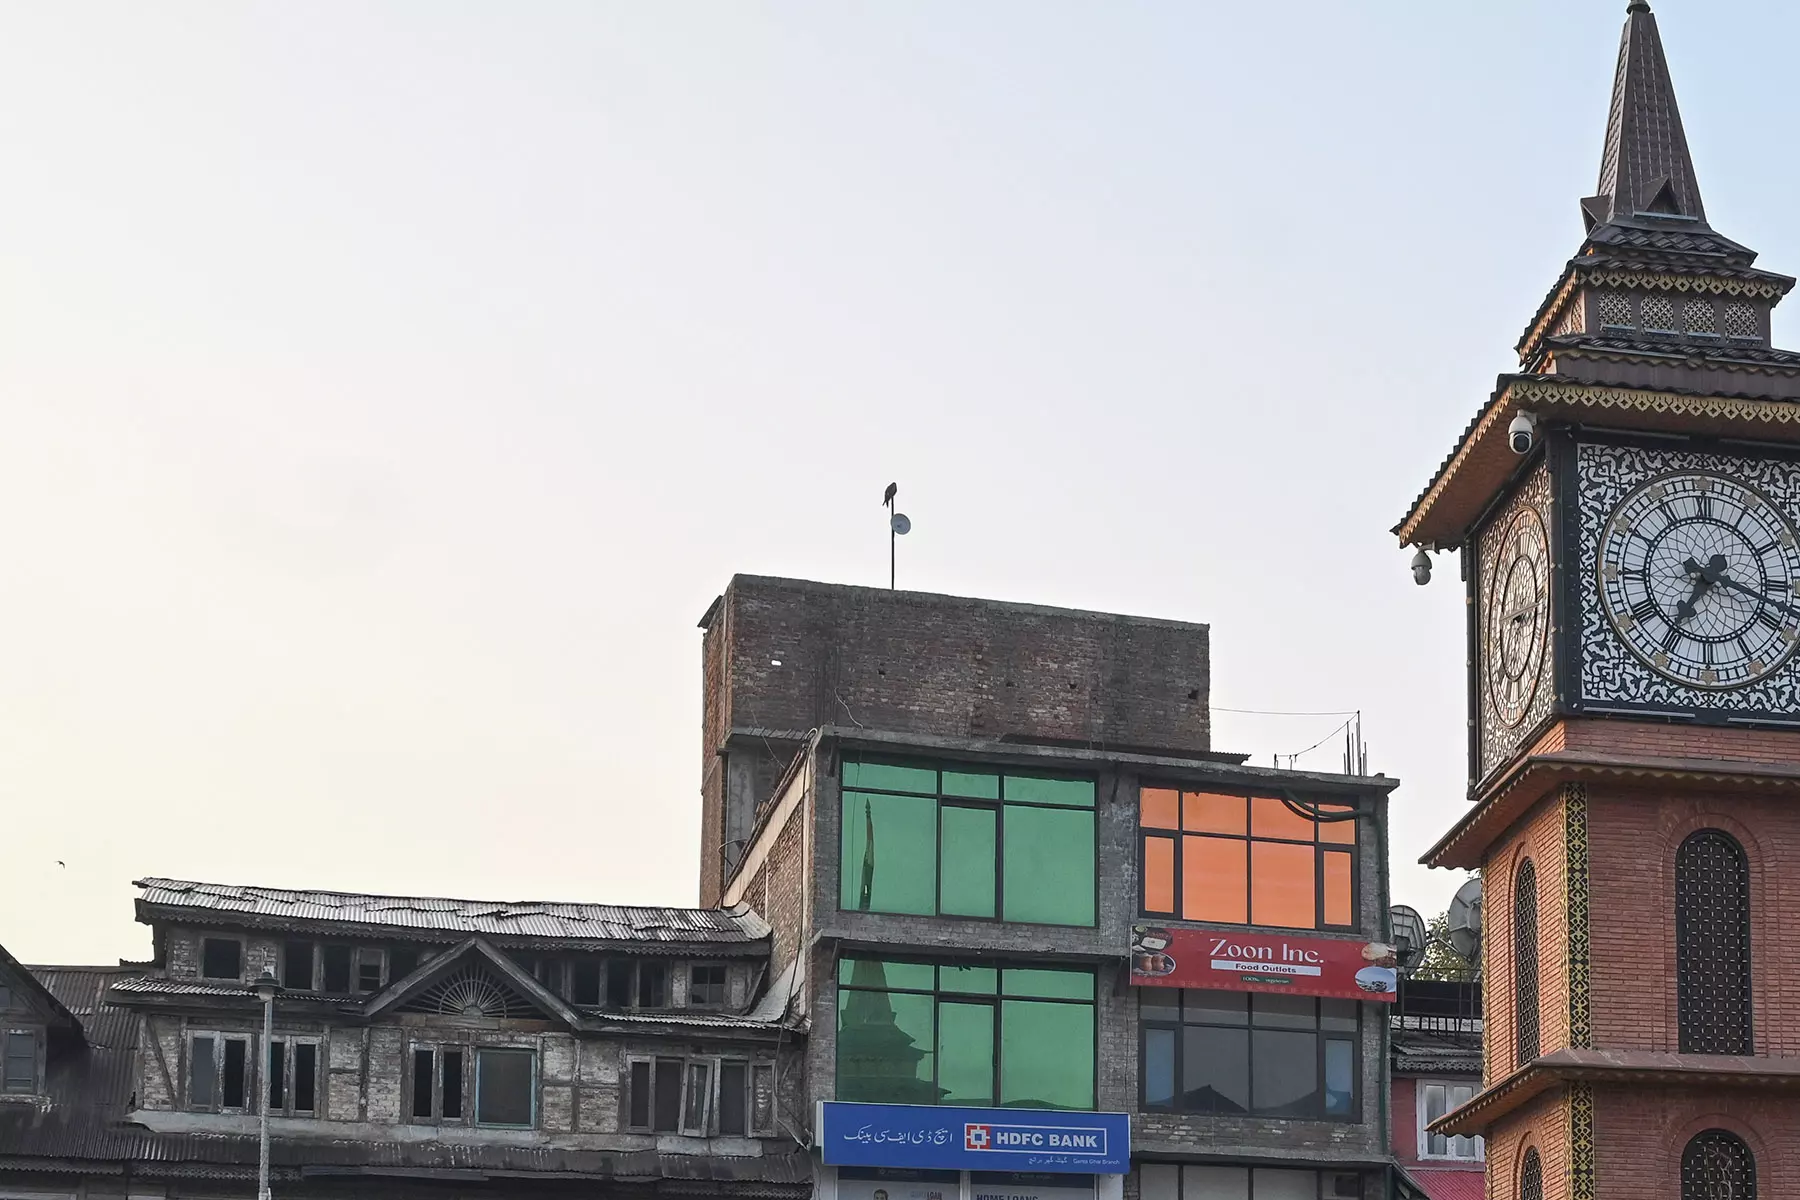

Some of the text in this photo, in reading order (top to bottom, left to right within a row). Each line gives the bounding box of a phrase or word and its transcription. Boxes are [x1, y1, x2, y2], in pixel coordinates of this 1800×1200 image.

[1209, 938, 1324, 963] Zoon Inc.
[1235, 963, 1297, 974] Food Outlets
[996, 1131, 1098, 1148] HDFC BANK
